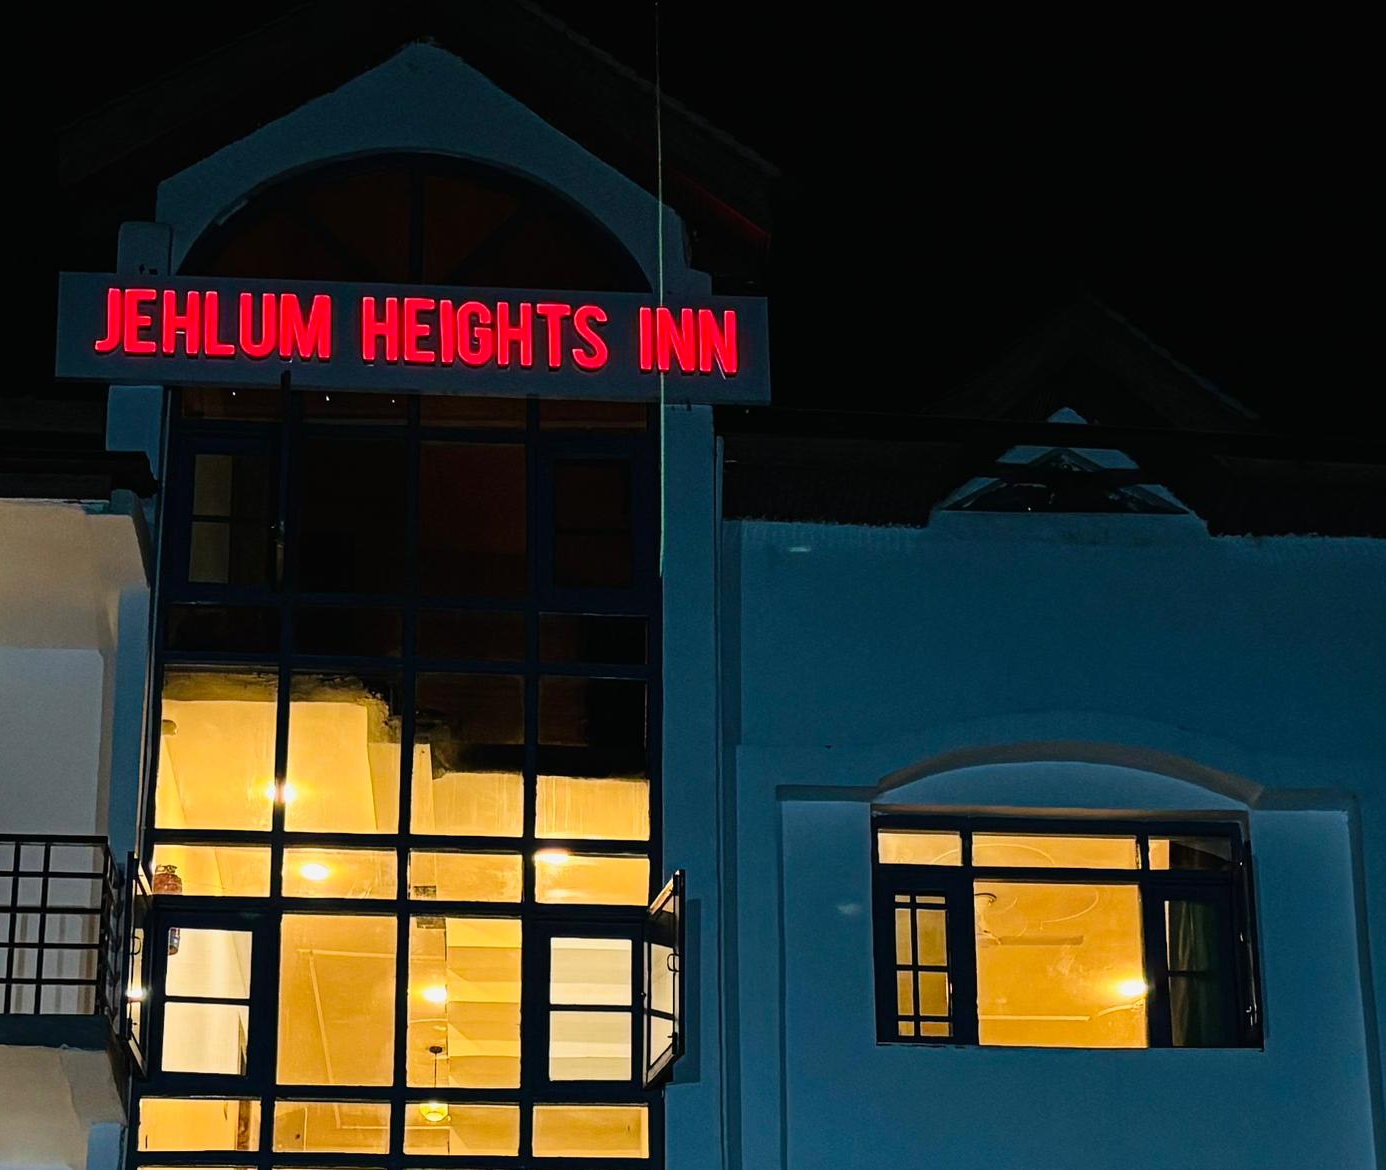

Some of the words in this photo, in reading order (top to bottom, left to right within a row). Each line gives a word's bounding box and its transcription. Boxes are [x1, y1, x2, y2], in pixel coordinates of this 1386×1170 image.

[94, 287, 332, 358] JEHLUM
[362, 296, 608, 368] HEIGHTS
[639, 307, 738, 374] INN
